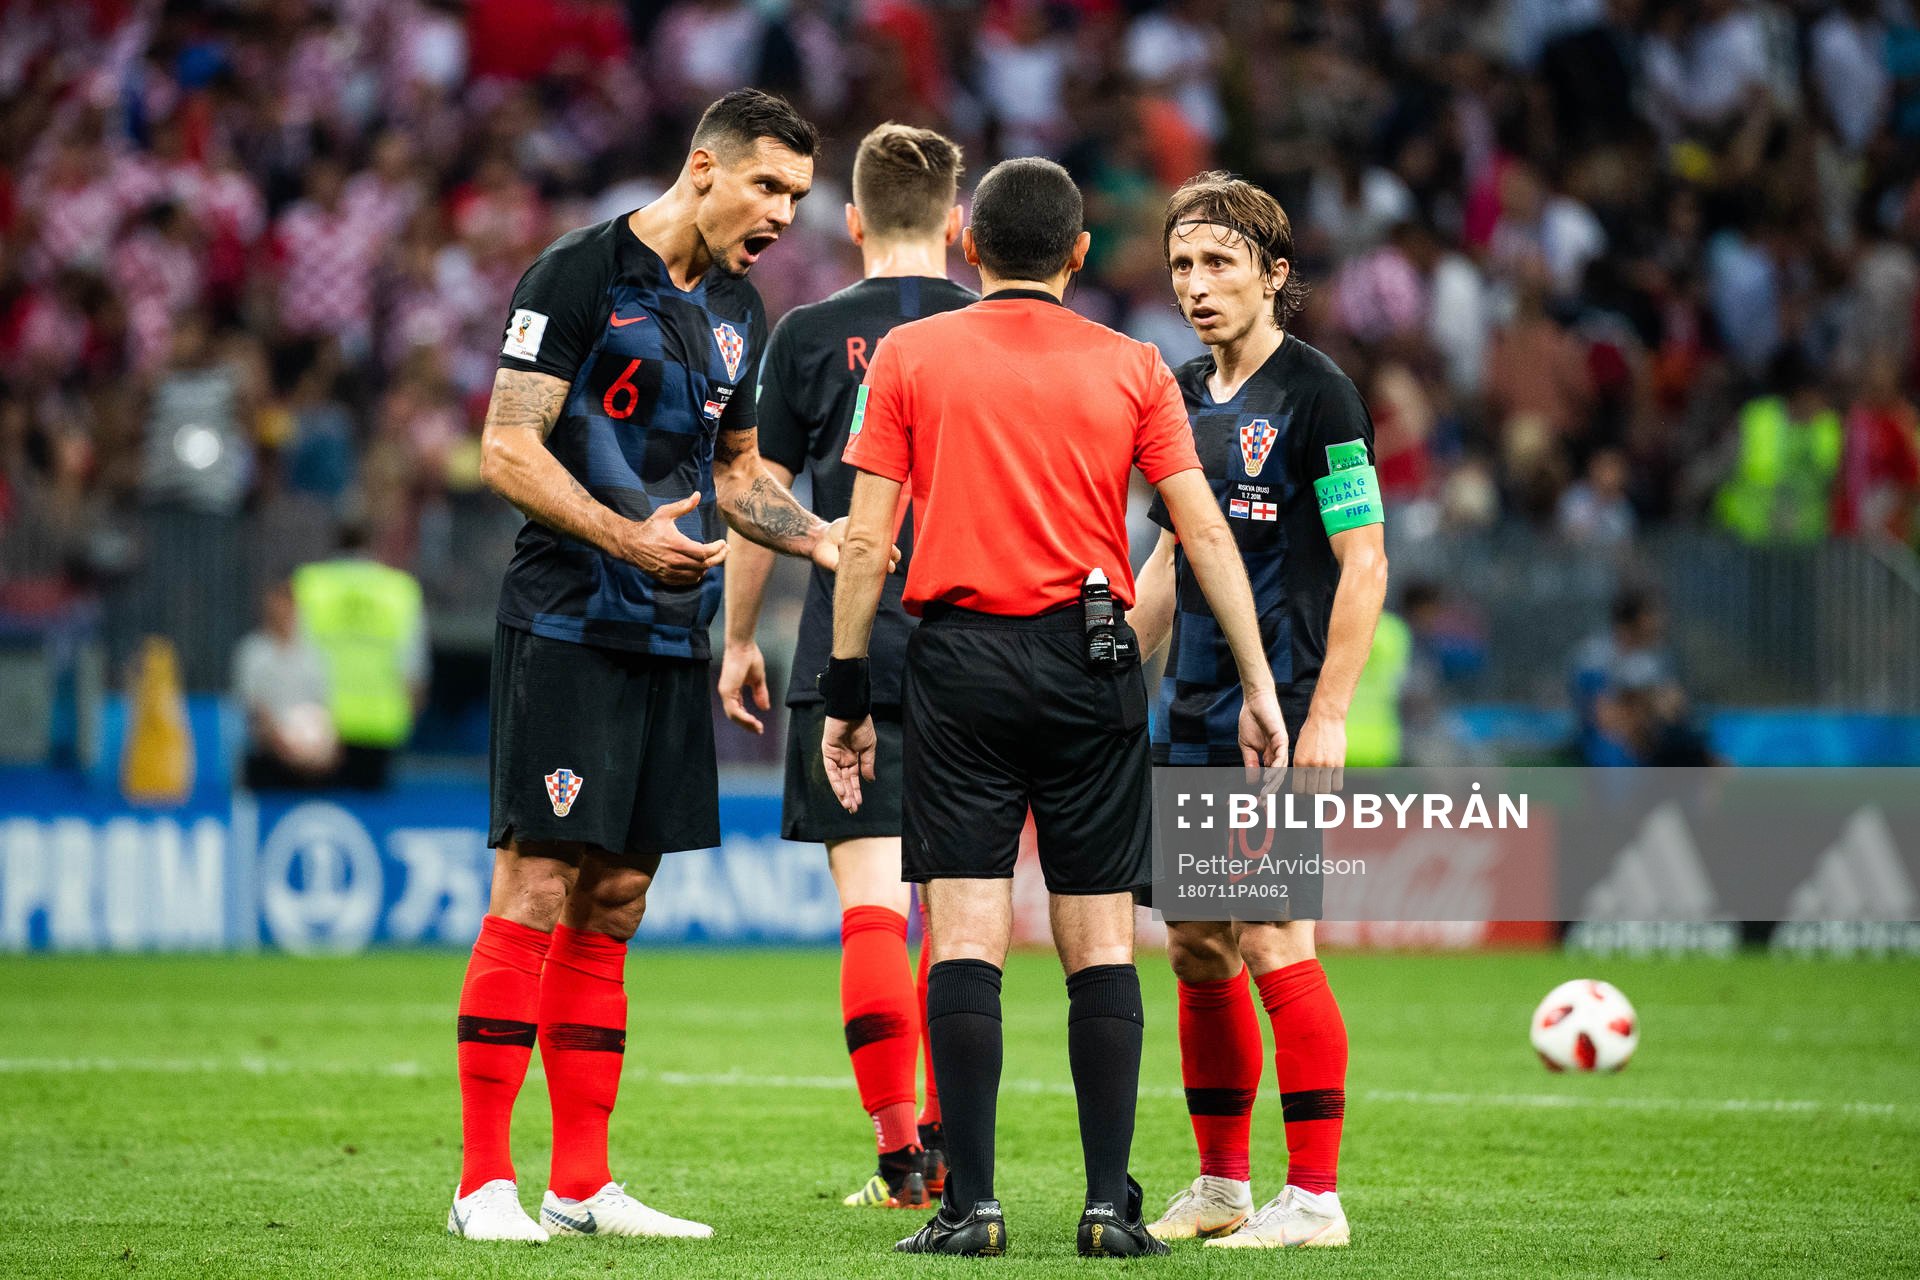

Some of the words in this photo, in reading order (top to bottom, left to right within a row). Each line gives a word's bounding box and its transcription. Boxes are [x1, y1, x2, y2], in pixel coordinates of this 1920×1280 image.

[846, 336, 884, 370] R
[603, 358, 642, 419] 6
[1345, 504, 1371, 518] FIFA
[1085, 1207, 1114, 1217] adidas
